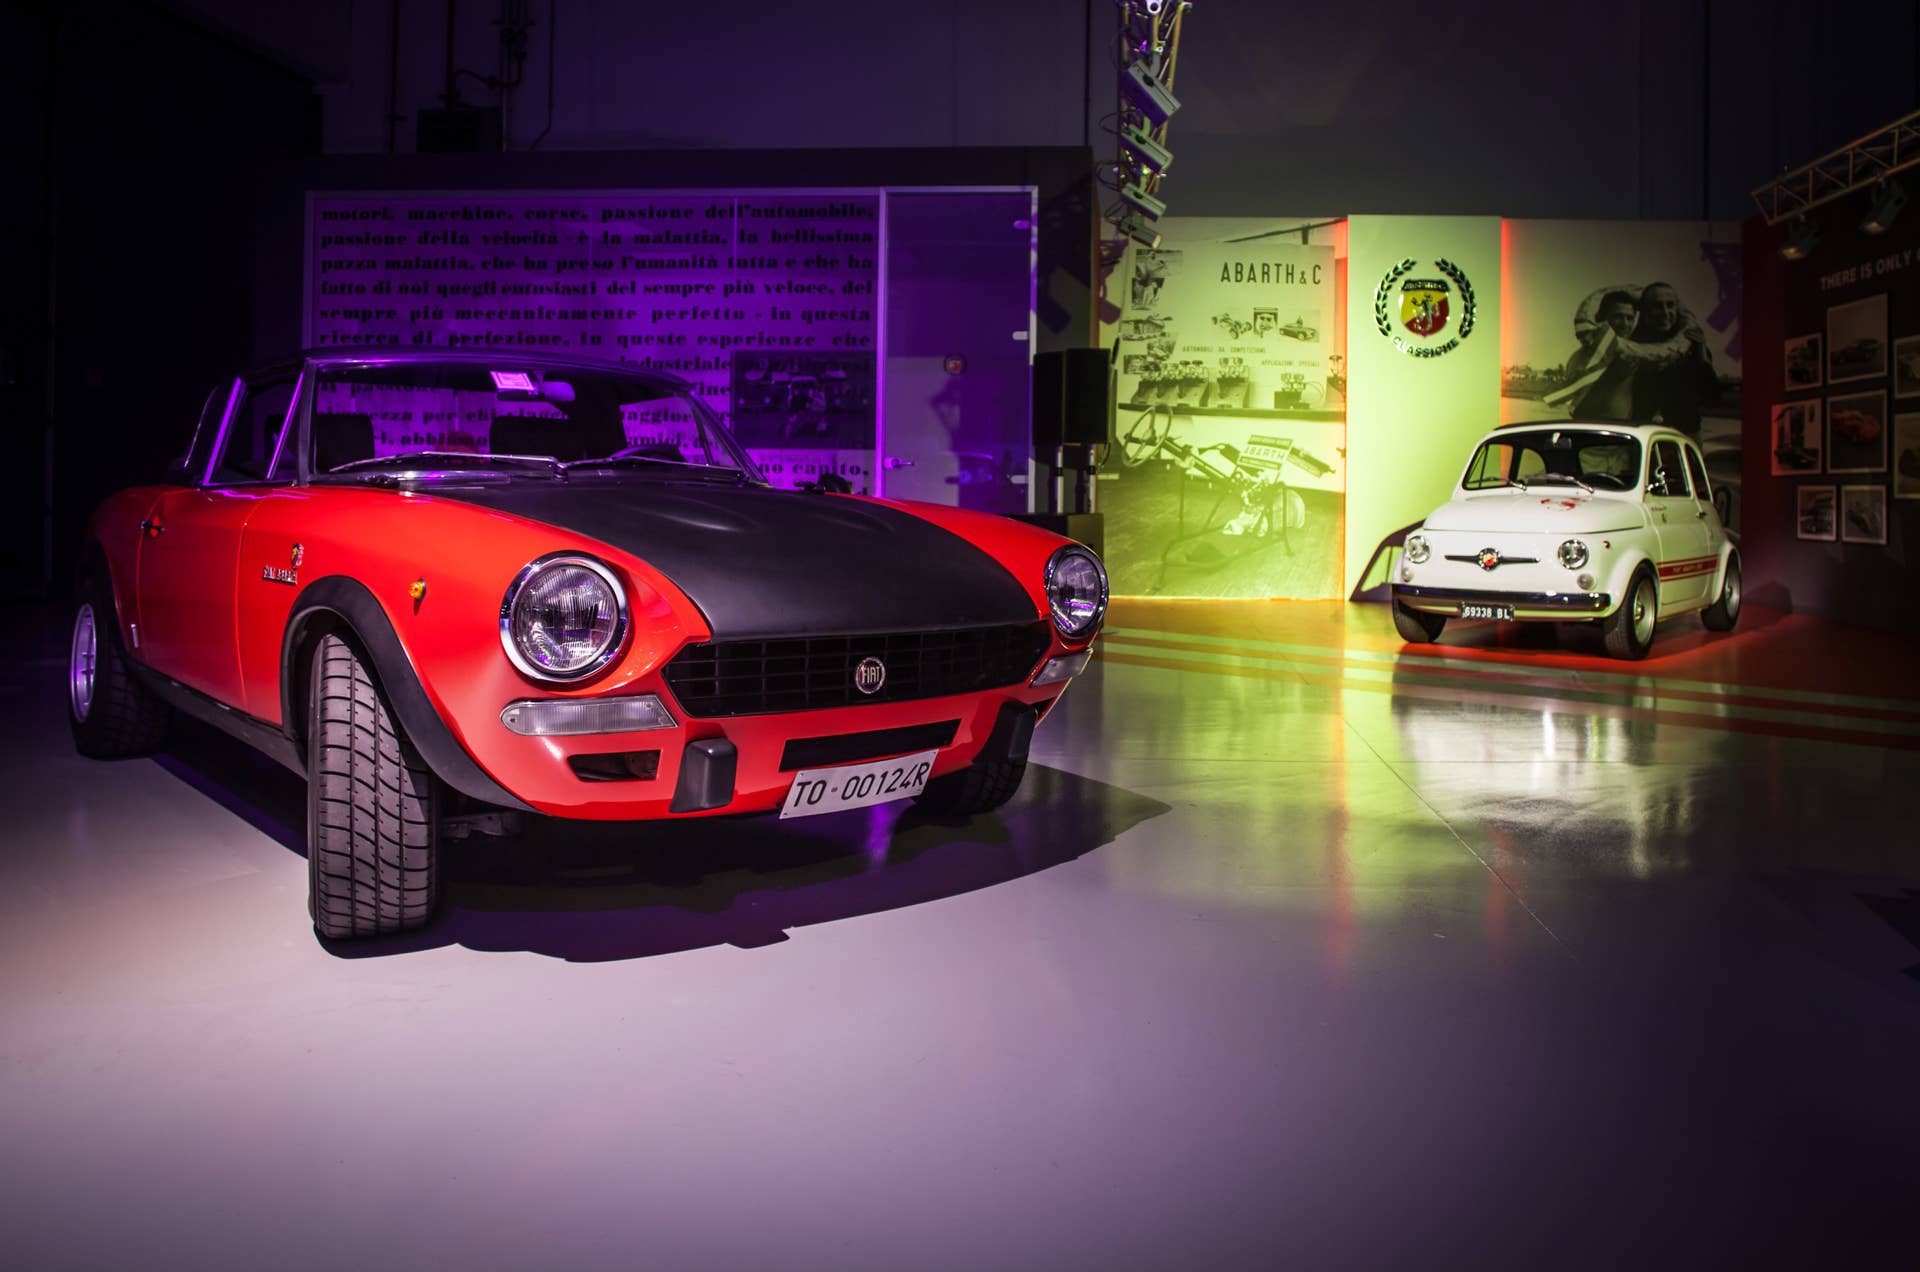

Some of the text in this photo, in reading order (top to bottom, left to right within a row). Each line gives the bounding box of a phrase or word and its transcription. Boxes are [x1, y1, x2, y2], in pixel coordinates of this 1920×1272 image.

[322, 206, 395, 220] motori,
[407, 205, 513, 220] macchine,
[601, 205, 694, 222] passione
[321, 231, 407, 248] passione
[418, 230, 469, 245] della
[482, 230, 558, 245] velocità
[603, 230, 621, 244] la
[633, 229, 727, 245] malattia,
[739, 229, 758, 244] la
[770, 228, 872, 244] bellissima
[321, 254, 872, 273] pazza malattia, che ha preso l'umanità tutta e che ha
[1820, 266, 1857, 292] THERE
[1860, 261, 1872, 280] IS
[1876, 248, 1912, 275] ONLY
[1221, 262, 1322, 285] ABARTH & C
[321, 280, 872, 298] fatto di noi quegli entusiasti del sempre più veloce, del
[320, 309, 396, 322] sempre
[410, 305, 443, 322] più
[455, 306, 637, 320] meccanicamente
[652, 307, 745, 322] perfetto
[771, 306, 791, 320] in
[801, 308, 870, 324] questa
[320, 330, 398, 344] ricerca
[412, 330, 432, 344] di
[617, 334, 686, 349] queste
[697, 331, 815, 349] esperienze
[832, 331, 870, 345] che
[861, 665, 880, 684] FIAT
[841, 762, 930, 800] 00124R
